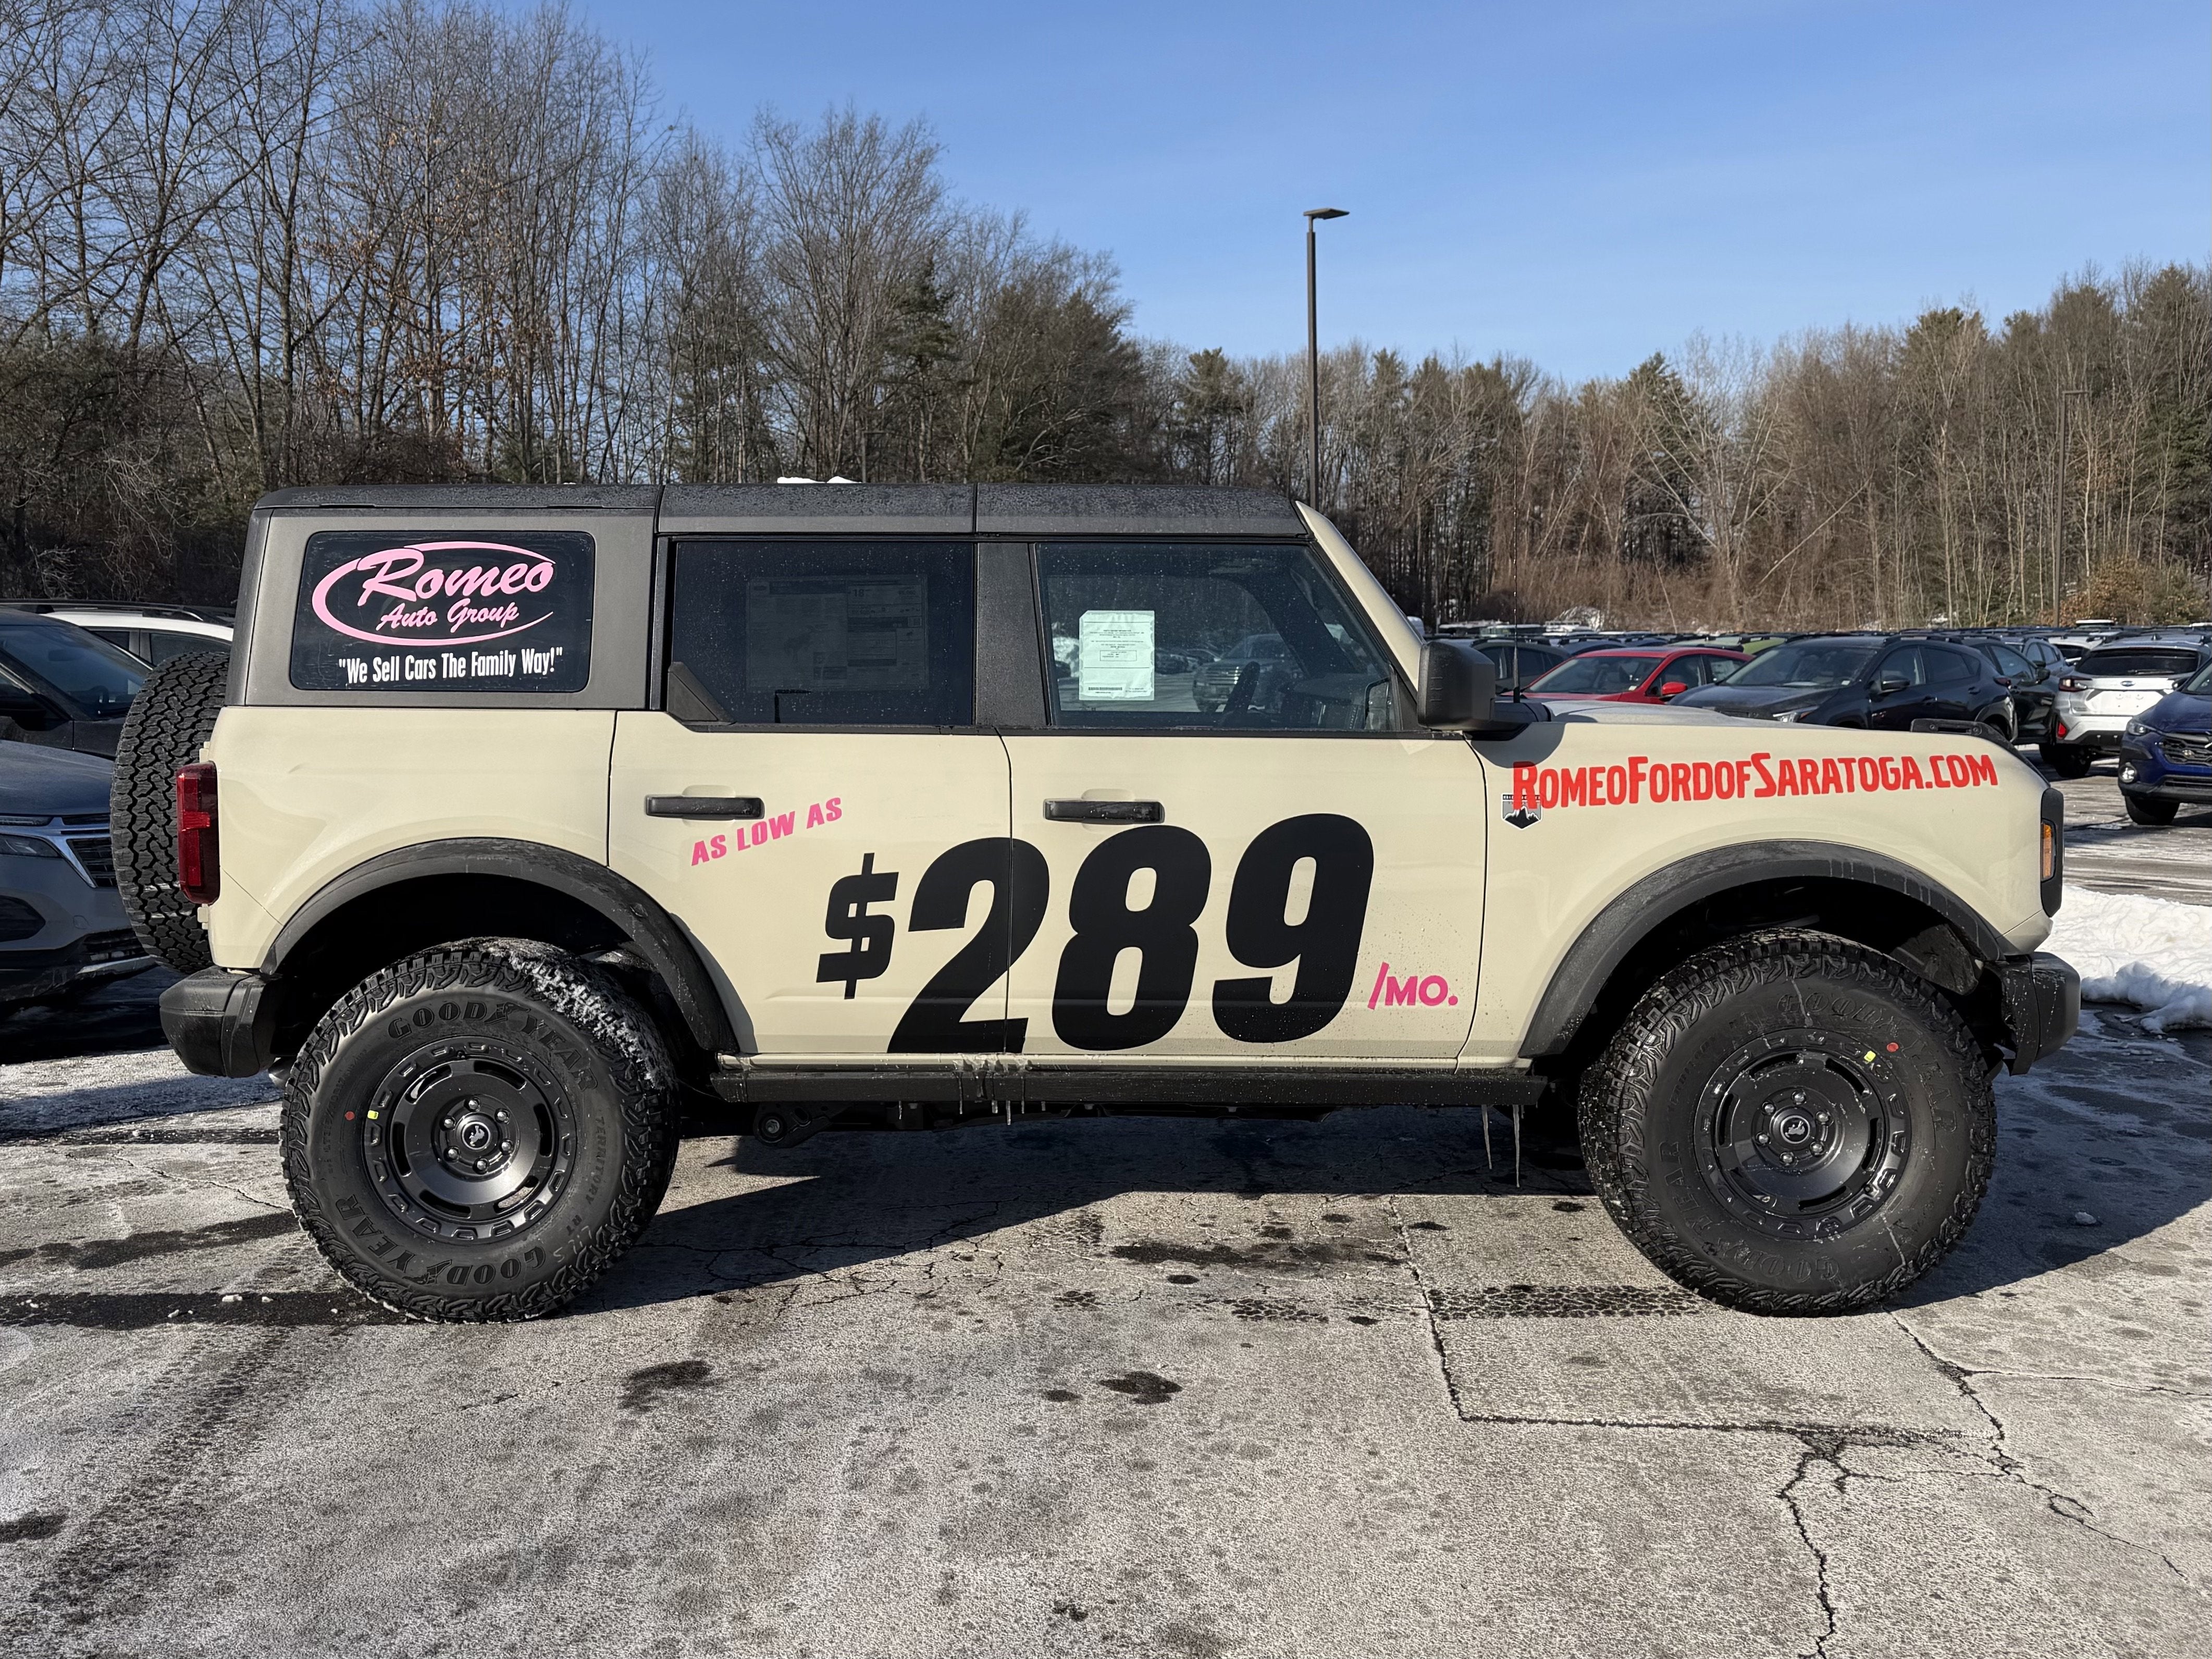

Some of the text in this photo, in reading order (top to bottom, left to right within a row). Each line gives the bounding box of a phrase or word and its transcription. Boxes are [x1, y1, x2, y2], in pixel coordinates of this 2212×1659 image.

[357, 548, 554, 606] Romeo
[376, 598, 520, 633] Auto Group
[339, 646, 563, 685] "We Sell Cars The Family Way!"
[691, 797, 842, 866] AS LOW AS
[816, 813, 1459, 1054] $289 /MO.
